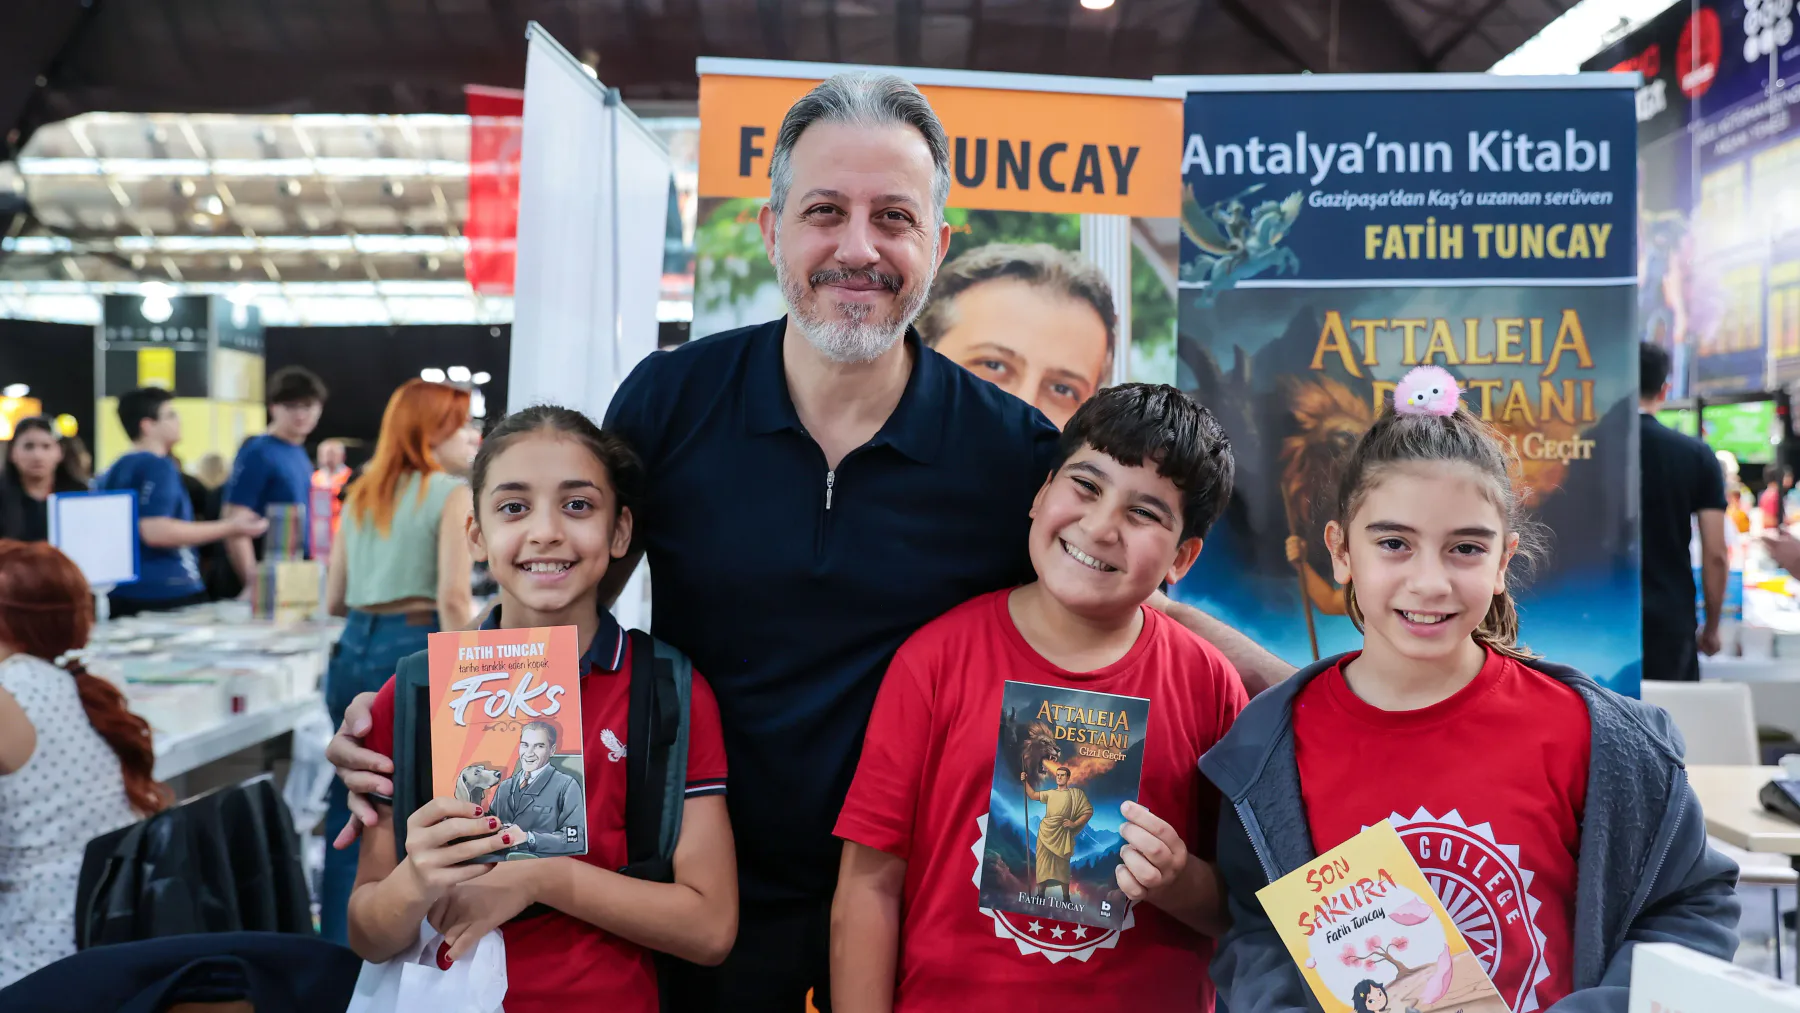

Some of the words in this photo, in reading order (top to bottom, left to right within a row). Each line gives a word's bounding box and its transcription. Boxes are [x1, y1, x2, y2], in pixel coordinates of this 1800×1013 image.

[945, 135, 1140, 196] UNCAY
[1468, 128, 1611, 173] Kitabı
[1476, 191, 1541, 206] uzanan
[1543, 188, 1613, 206] serüven
[1364, 216, 1464, 260] FATİH
[1472, 223, 1613, 259] TUNCAY
[1310, 309, 1595, 379] ATTALEIA
[496, 642, 545, 659] TUNCAY
[1036, 699, 1131, 733] ATTALEIA
[1054, 725, 1130, 750] DESTANI
[1306, 856, 1350, 893] SON
[1420, 835, 1522, 926] COLLEGE
[1047, 896, 1085, 914] TUNCAY
[1298, 869, 1397, 936] SAKURA
[1325, 926, 1352, 944] Fatih
[1350, 907, 1386, 930] Tuncay
